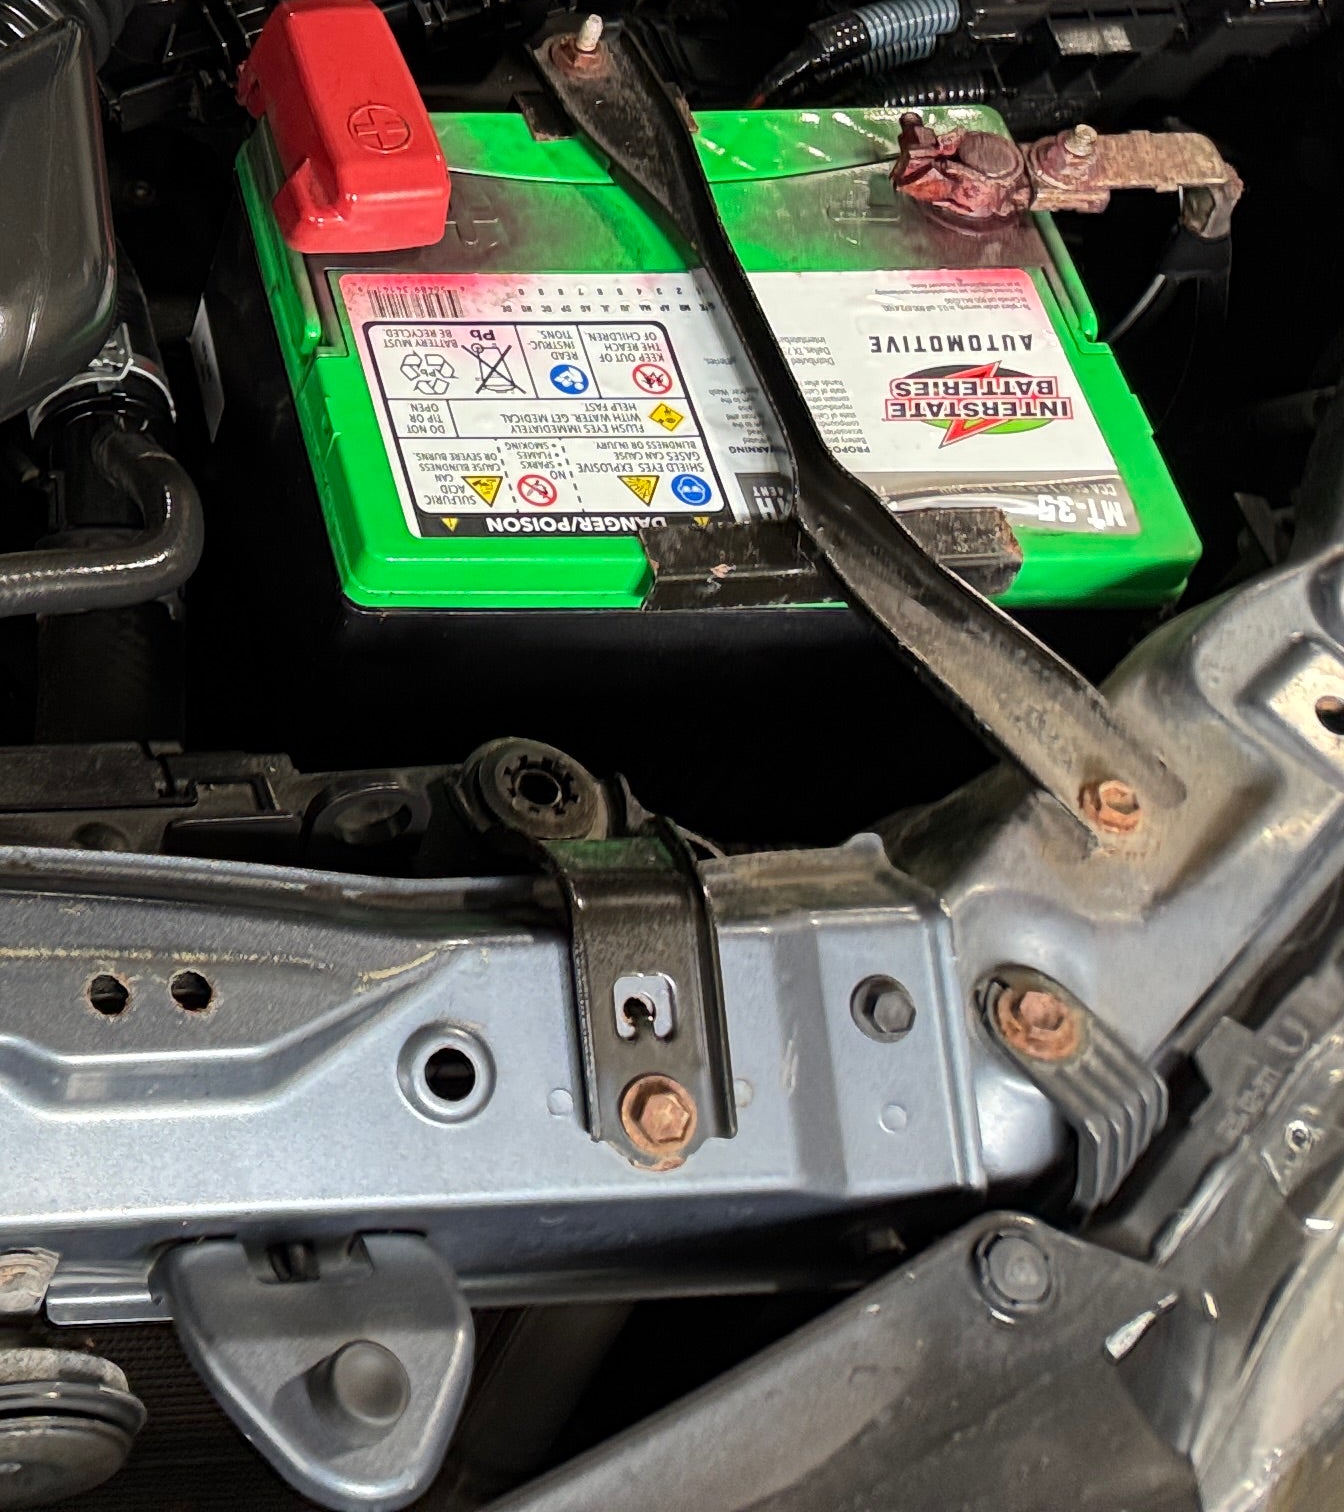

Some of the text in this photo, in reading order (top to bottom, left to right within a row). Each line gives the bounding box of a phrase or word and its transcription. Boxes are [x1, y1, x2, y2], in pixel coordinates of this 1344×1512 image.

[382, 329, 452, 338] BE RECYCLED.
[470, 329, 495, 340] Pb
[537, 331, 572, 339] TIONS.
[585, 332, 657, 341] OF CHILDREN.
[383, 339, 458, 348] BATTERY MUST
[527, 341, 575, 350] INSTRUC-
[605, 342, 661, 351] THE REACH
[868, 334, 1032, 353] AUTOMOTIVE
[551, 352, 579, 360] READ
[599, 353, 664, 362] KEEP OUT OF
[420, 369, 436, 377] Pb
[895, 380, 1053, 397] BATTERIES
[610, 403, 635, 411] HELP
[890, 401, 1068, 418] INTERSTATE
[409, 414, 443, 423] TIP OR
[500, 413, 641, 423] WITH WATER. GET MEDICAL
[406, 425, 445, 434] DO NOT
[510, 424, 644, 434] FLUSH EYES IMMEDIATELY
[504, 442, 549, 450] SMOKING
[631, 441, 644, 449] OR
[646, 441, 695, 449] BLINDNESS
[412, 452, 498, 461] OR SEVERE BURNS.
[516, 451, 552, 459] FLAMES
[613, 452, 700, 461] GASES CAN CAUSE
[419, 463, 501, 471] CAUSE BLINDNESS
[520, 461, 555, 469] SPARKS
[576, 463, 633, 473] EXPLOSIVE
[666, 462, 704, 472] SHIELD
[434, 474, 454, 482] CAN
[550, 471, 566, 479] NO
[440, 484, 465, 494] ACID
[423, 495, 476, 505] SULFURIC
[1037, 494, 1128, 529] MT-35
[485, 516, 667, 532] DANGER/POISON
